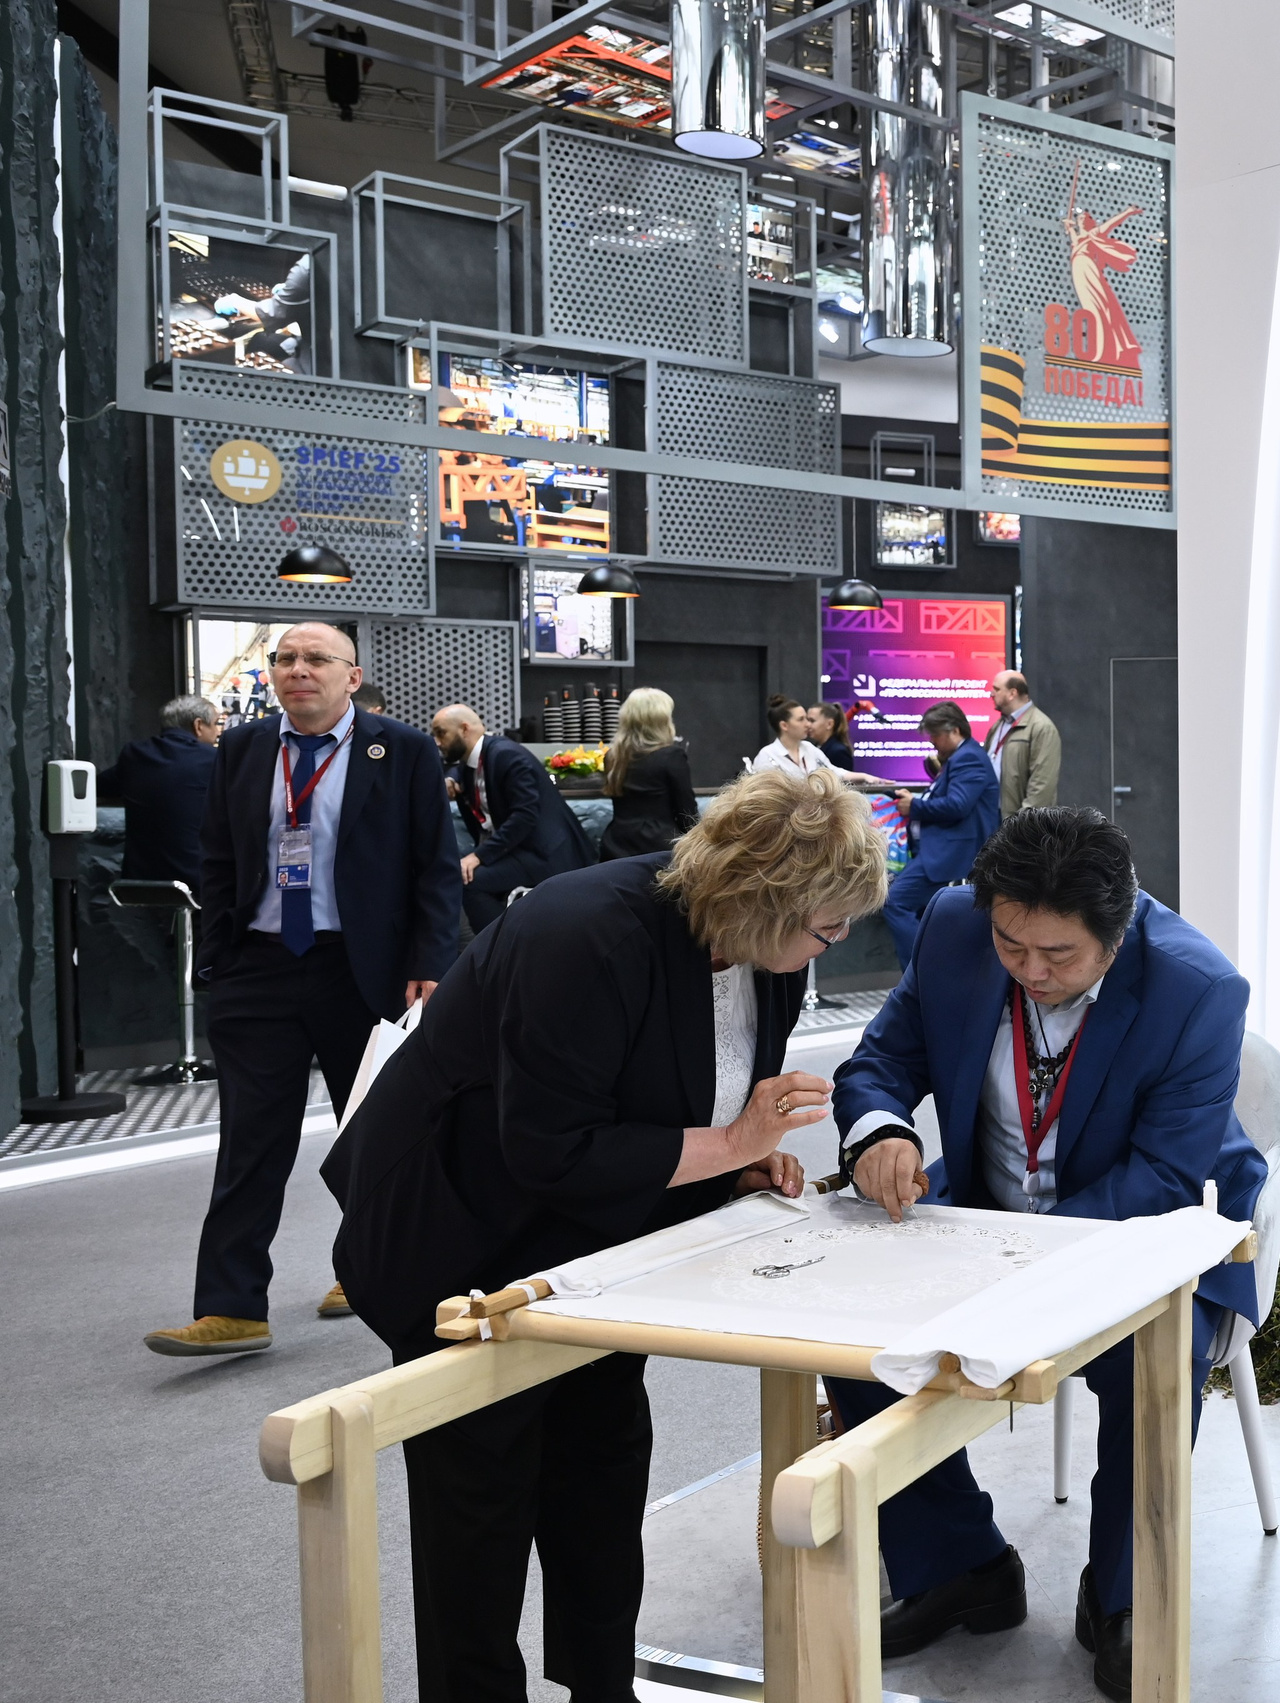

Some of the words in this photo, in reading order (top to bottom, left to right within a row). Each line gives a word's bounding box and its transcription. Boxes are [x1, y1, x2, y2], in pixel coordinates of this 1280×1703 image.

[1044, 303, 1098, 361] 80
[1044, 366, 1144, 408] ПОБЕДА!
[299, 521, 404, 539] ROSCONGRESS
